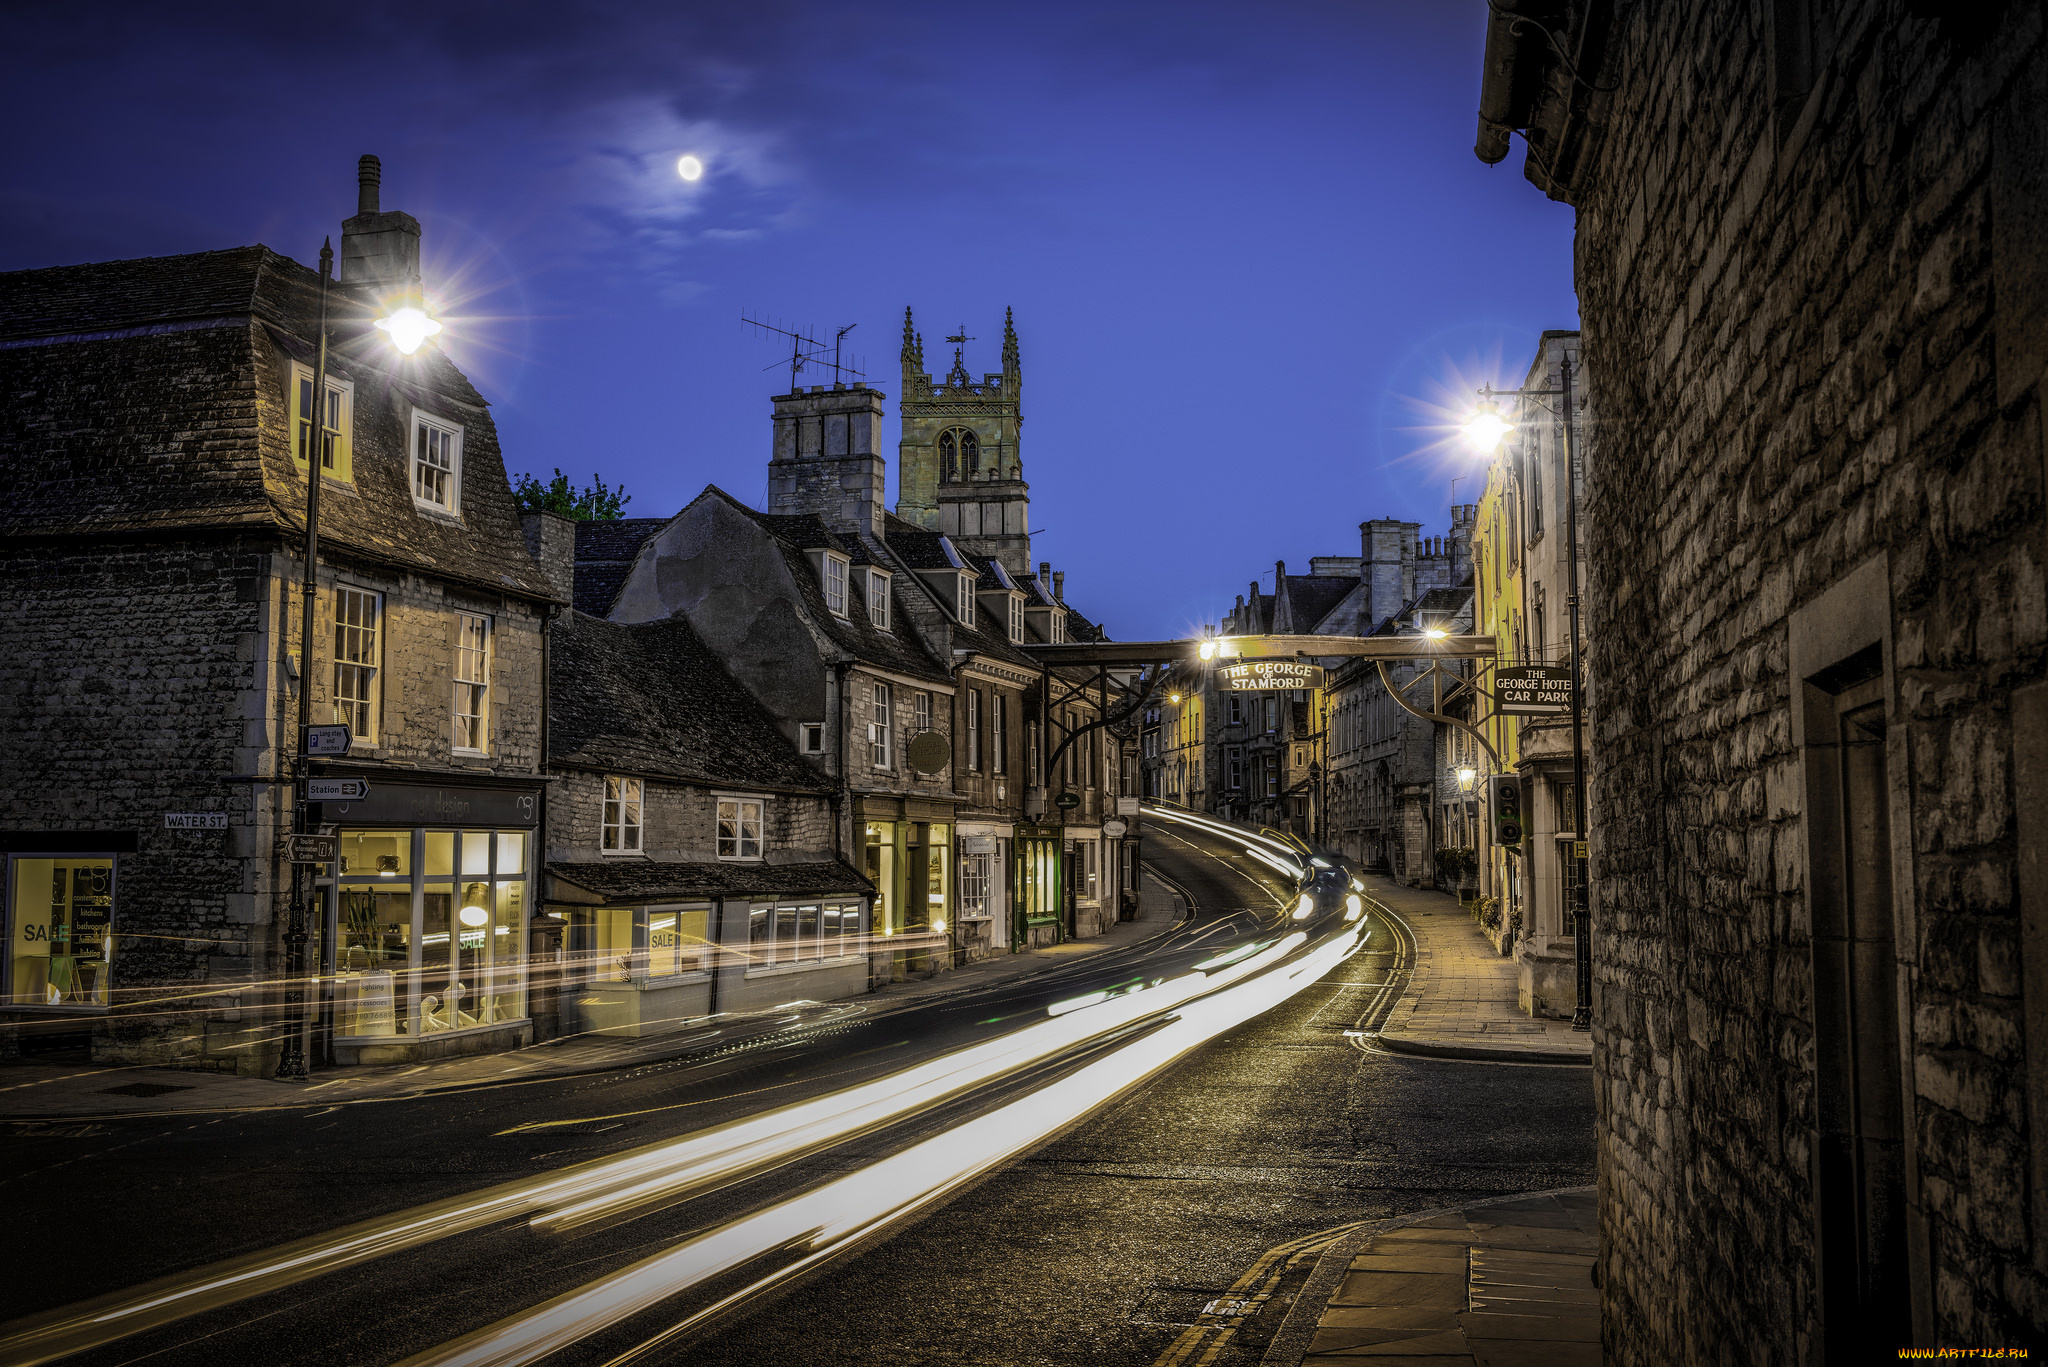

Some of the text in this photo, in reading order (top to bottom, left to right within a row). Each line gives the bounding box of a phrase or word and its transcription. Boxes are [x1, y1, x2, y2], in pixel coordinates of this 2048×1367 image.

[1220, 663, 1313, 679] THE GEORGE
[1525, 670, 1546, 679] THE
[1231, 677, 1305, 689] STAMFORD
[1496, 678, 1573, 690] GEORGE HOTE
[1504, 691, 1570, 702] CAR PARK
[319, 730, 342, 738] Long stay
[310, 785, 340, 794] Station
[433, 790, 471, 817] design
[167, 816, 207, 828] WATER
[1576, 843, 1586, 856] H
[23, 923, 71, 942] SALE
[652, 934, 673, 948] SALE
